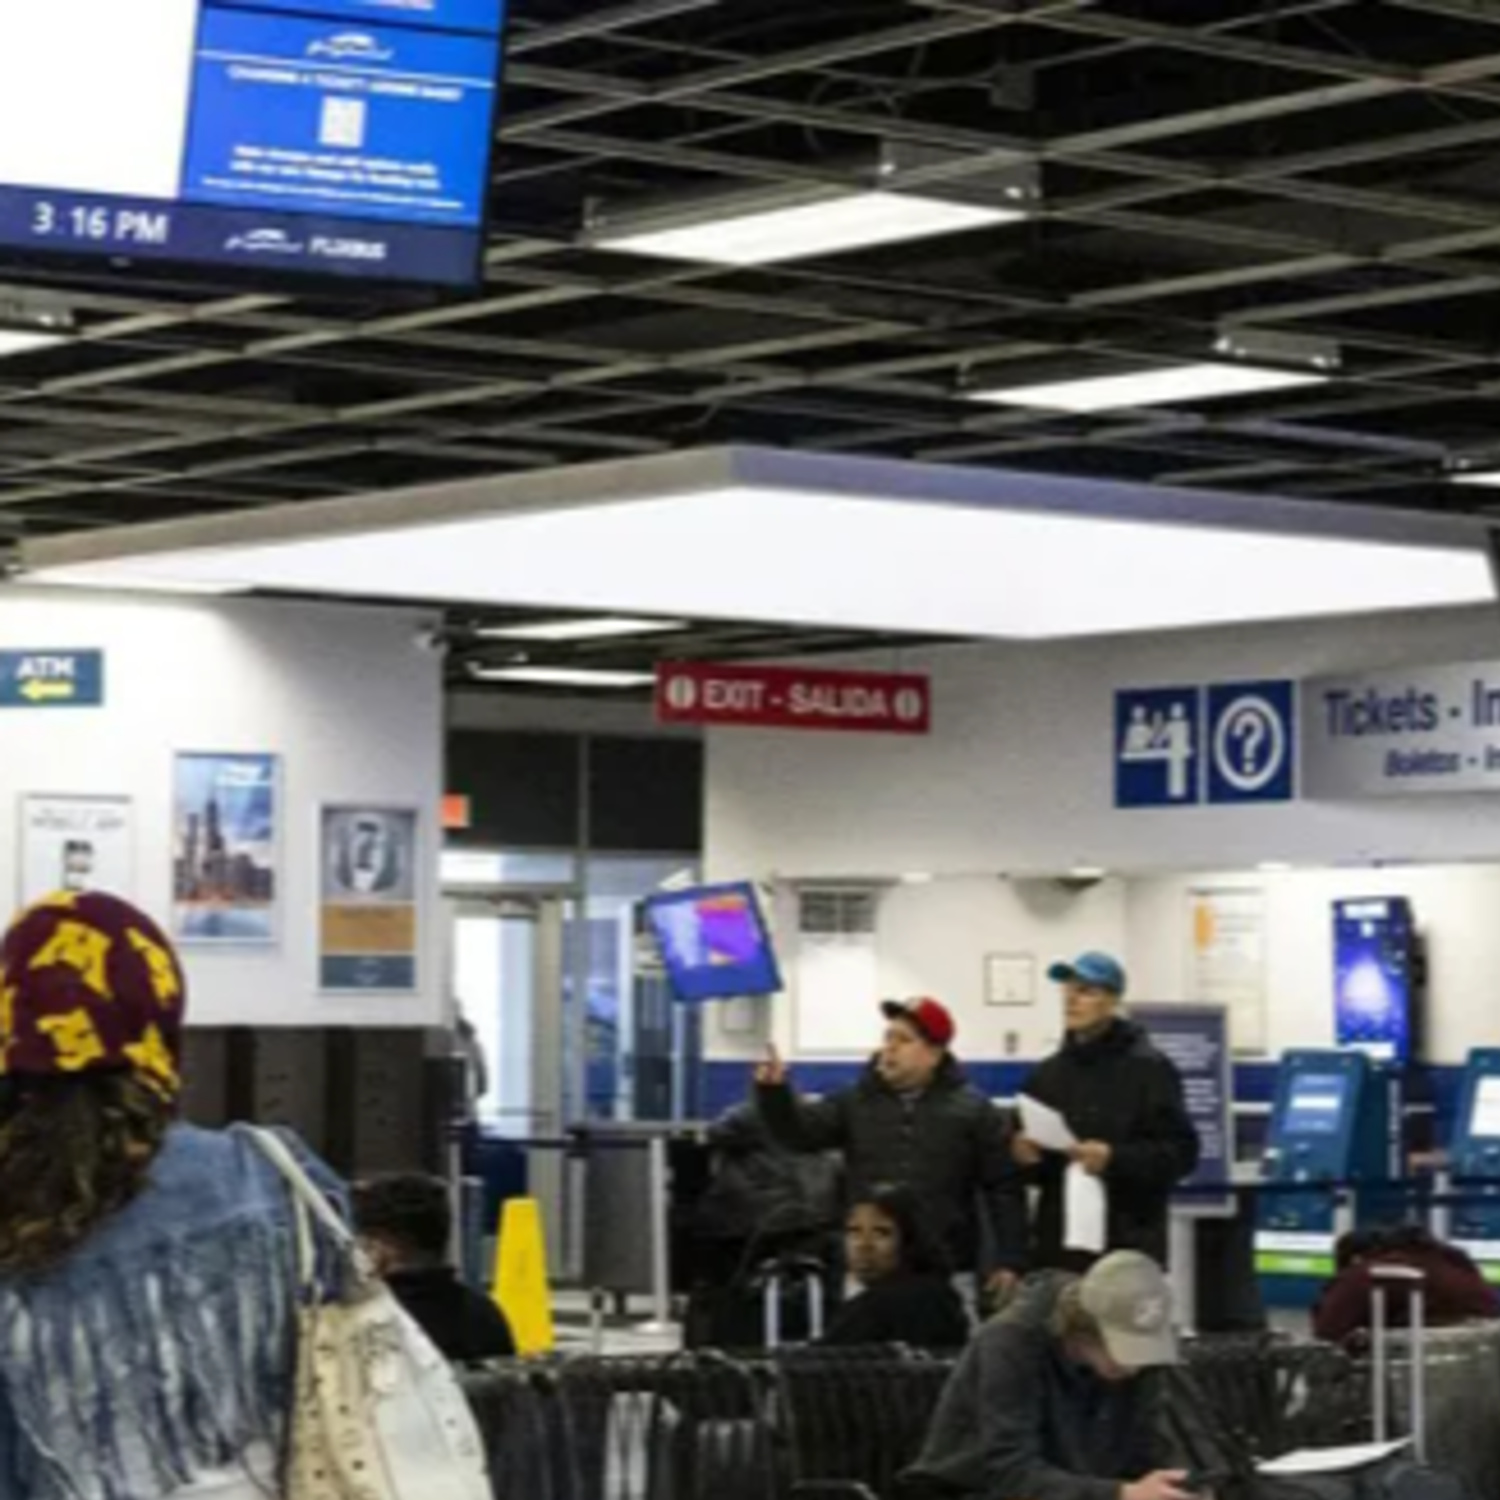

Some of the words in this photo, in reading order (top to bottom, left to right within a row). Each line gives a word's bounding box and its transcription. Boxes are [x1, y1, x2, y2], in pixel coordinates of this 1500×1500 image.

[115, 210, 169, 244] PM
[17, 657, 76, 677] ATM
[702, 679, 765, 711] EXIT
[788, 682, 890, 718] SALIDA
[1323, 688, 1438, 737] Tickets
